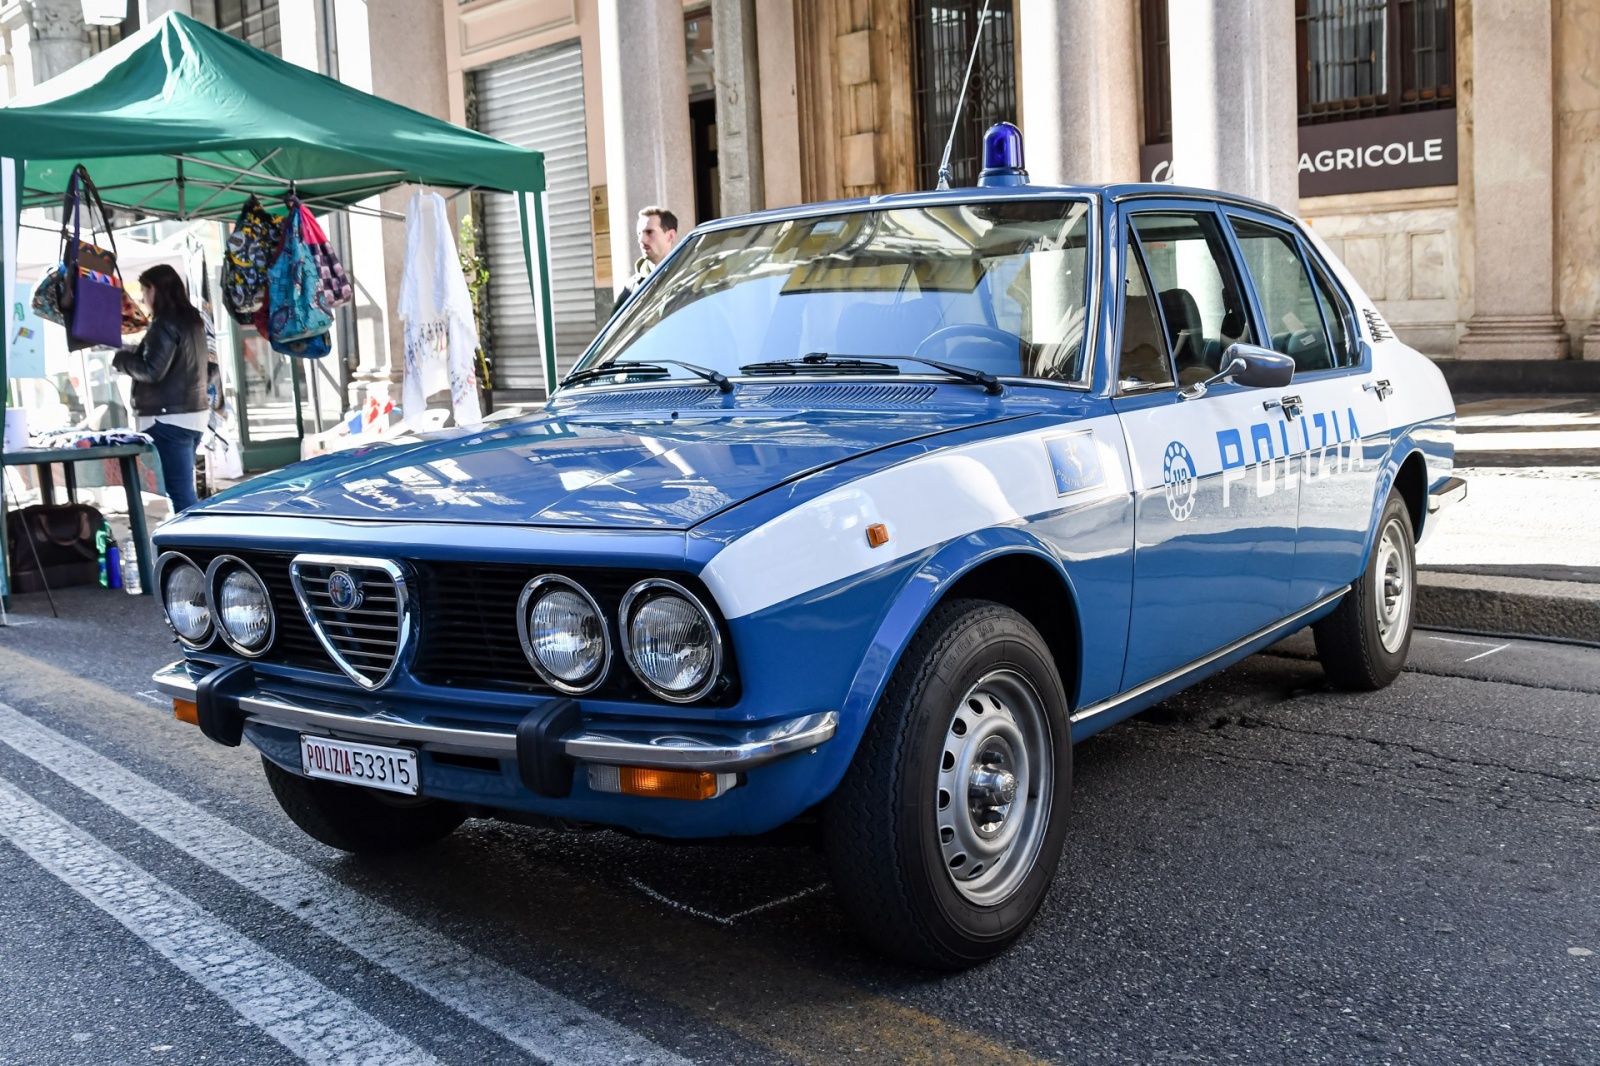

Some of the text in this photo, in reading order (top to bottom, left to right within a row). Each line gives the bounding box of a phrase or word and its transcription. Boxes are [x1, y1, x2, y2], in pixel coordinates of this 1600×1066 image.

[1298, 138, 1443, 174] AGRICOLE
[1216, 407, 1364, 508] POLIZIA
[1172, 467, 1188, 496] 113
